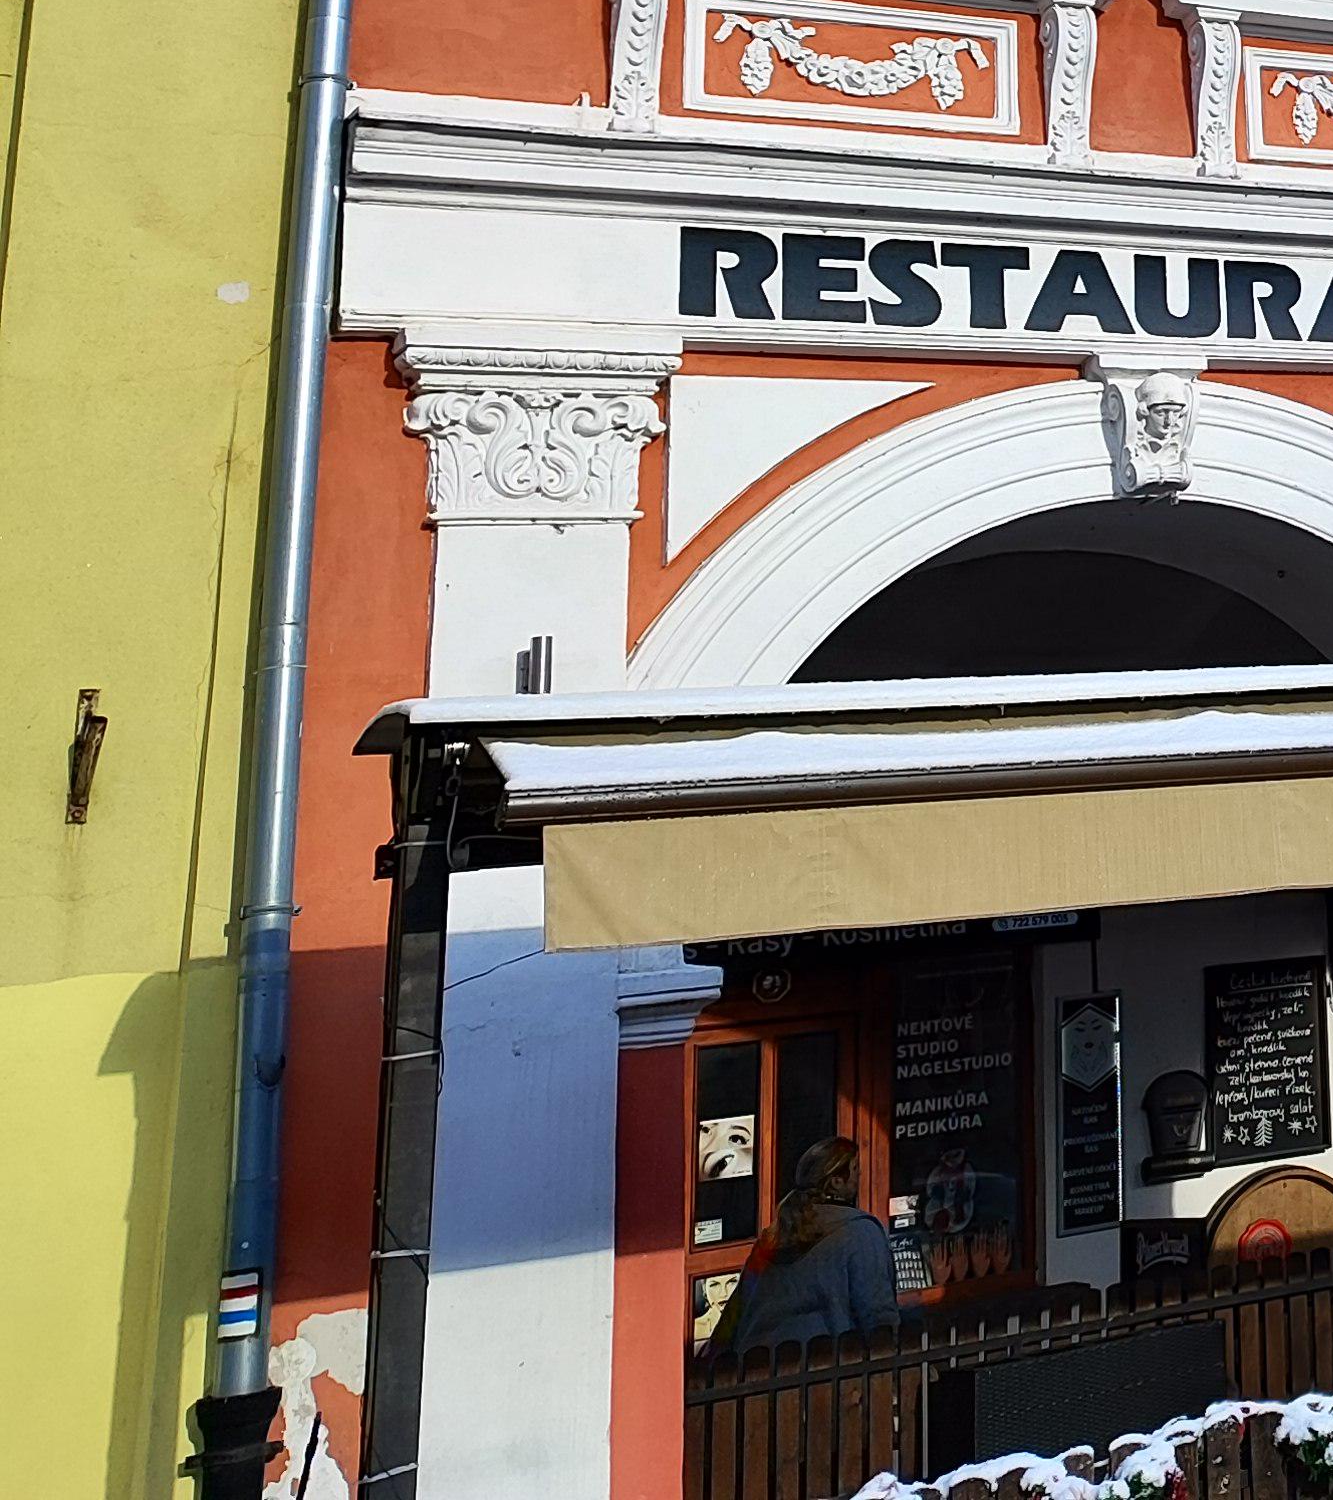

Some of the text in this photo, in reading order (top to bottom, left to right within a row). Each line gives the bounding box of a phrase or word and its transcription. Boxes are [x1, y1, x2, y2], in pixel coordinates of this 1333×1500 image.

[897, 1012, 975, 1037] NEHTOVÉ
[896, 1039, 960, 1059] STUDIO
[896, 1051, 1013, 1080] NAGELSTUDIO
